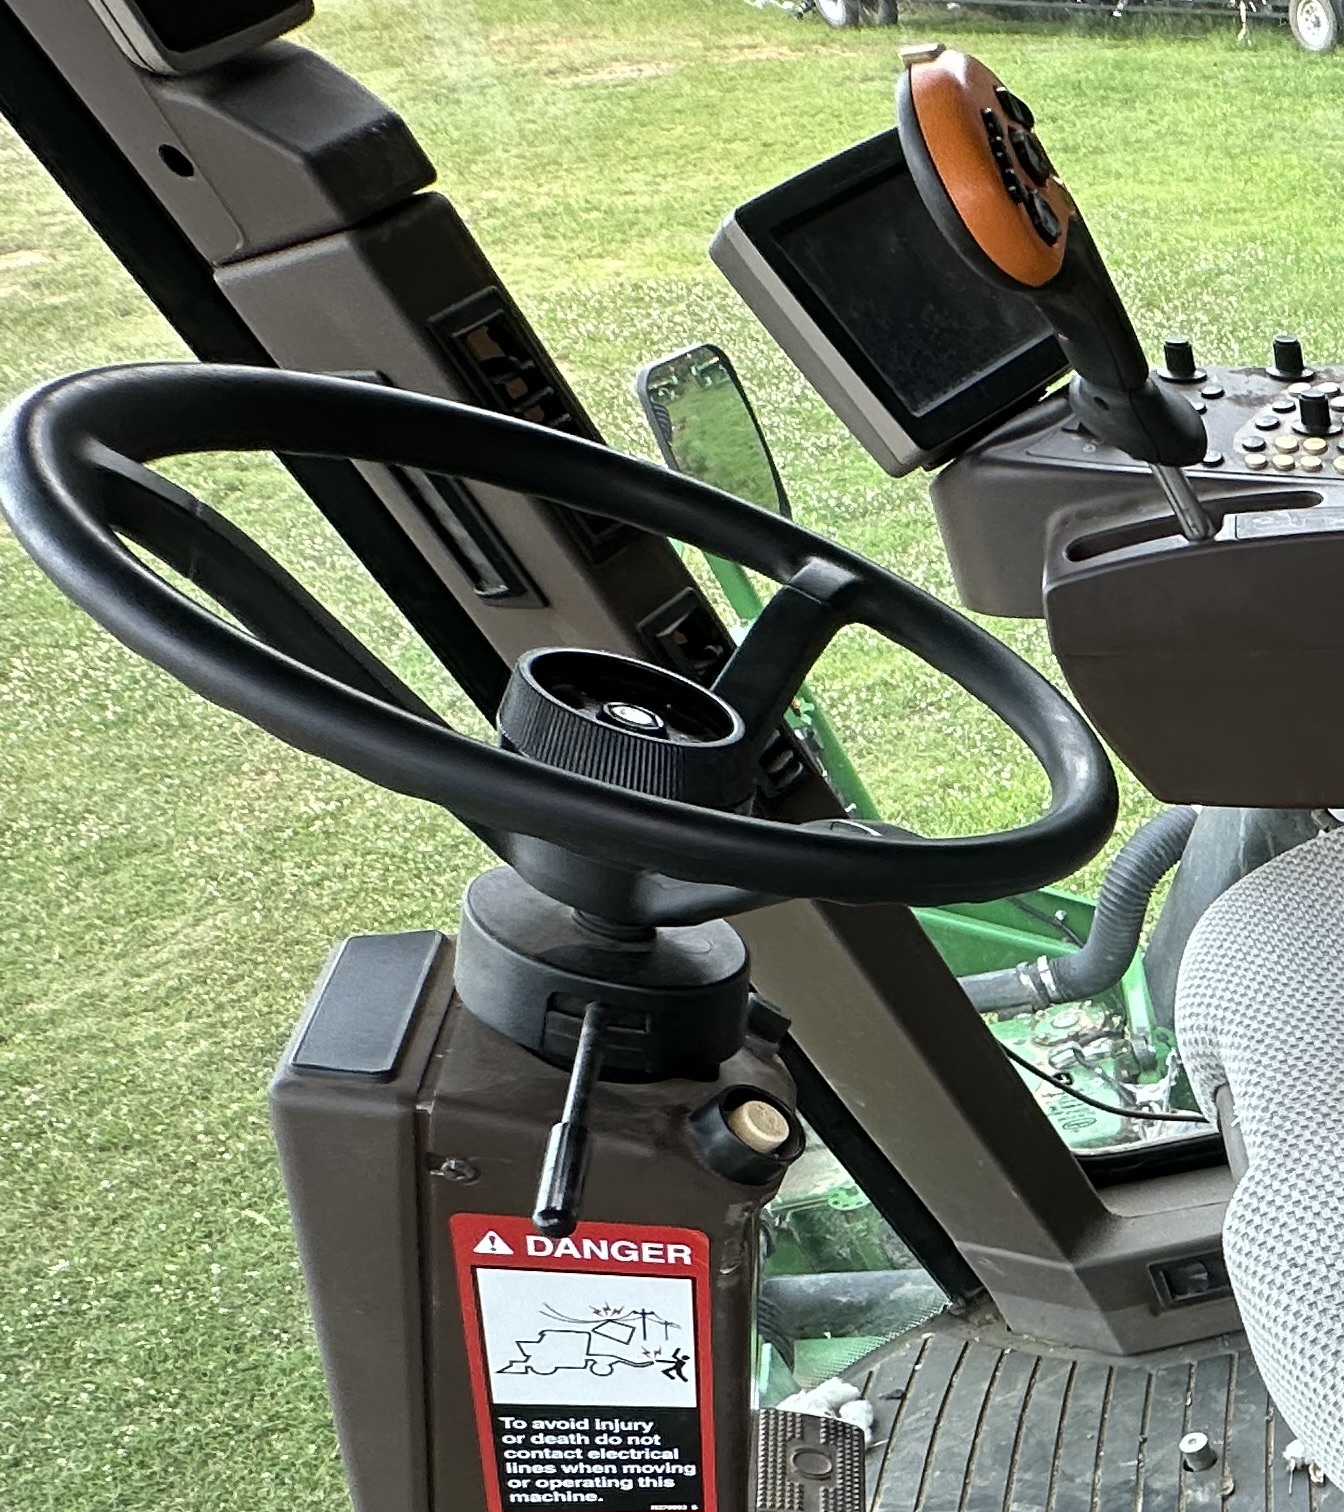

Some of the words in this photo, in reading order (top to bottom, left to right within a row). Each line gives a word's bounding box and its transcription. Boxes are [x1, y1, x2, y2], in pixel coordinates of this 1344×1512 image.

[525, 1235, 692, 1265] DANGER
[498, 1417, 528, 1430] To
[531, 1418, 590, 1431] avoid
[594, 1418, 654, 1433] injury
[502, 1435, 526, 1446] or
[530, 1433, 590, 1445] death
[594, 1434, 623, 1446] do
[627, 1434, 661, 1446] not
[503, 1448, 584, 1460] contact
[587, 1448, 679, 1460] electrical
[505, 1462, 557, 1474] lines
[561, 1462, 617, 1474] when
[622, 1463, 697, 1476] moving
[507, 1477, 531, 1488] or
[535, 1476, 634, 1490] operating
[637, 1476, 676, 1488] this
[509, 1490, 604, 1503] machine.
